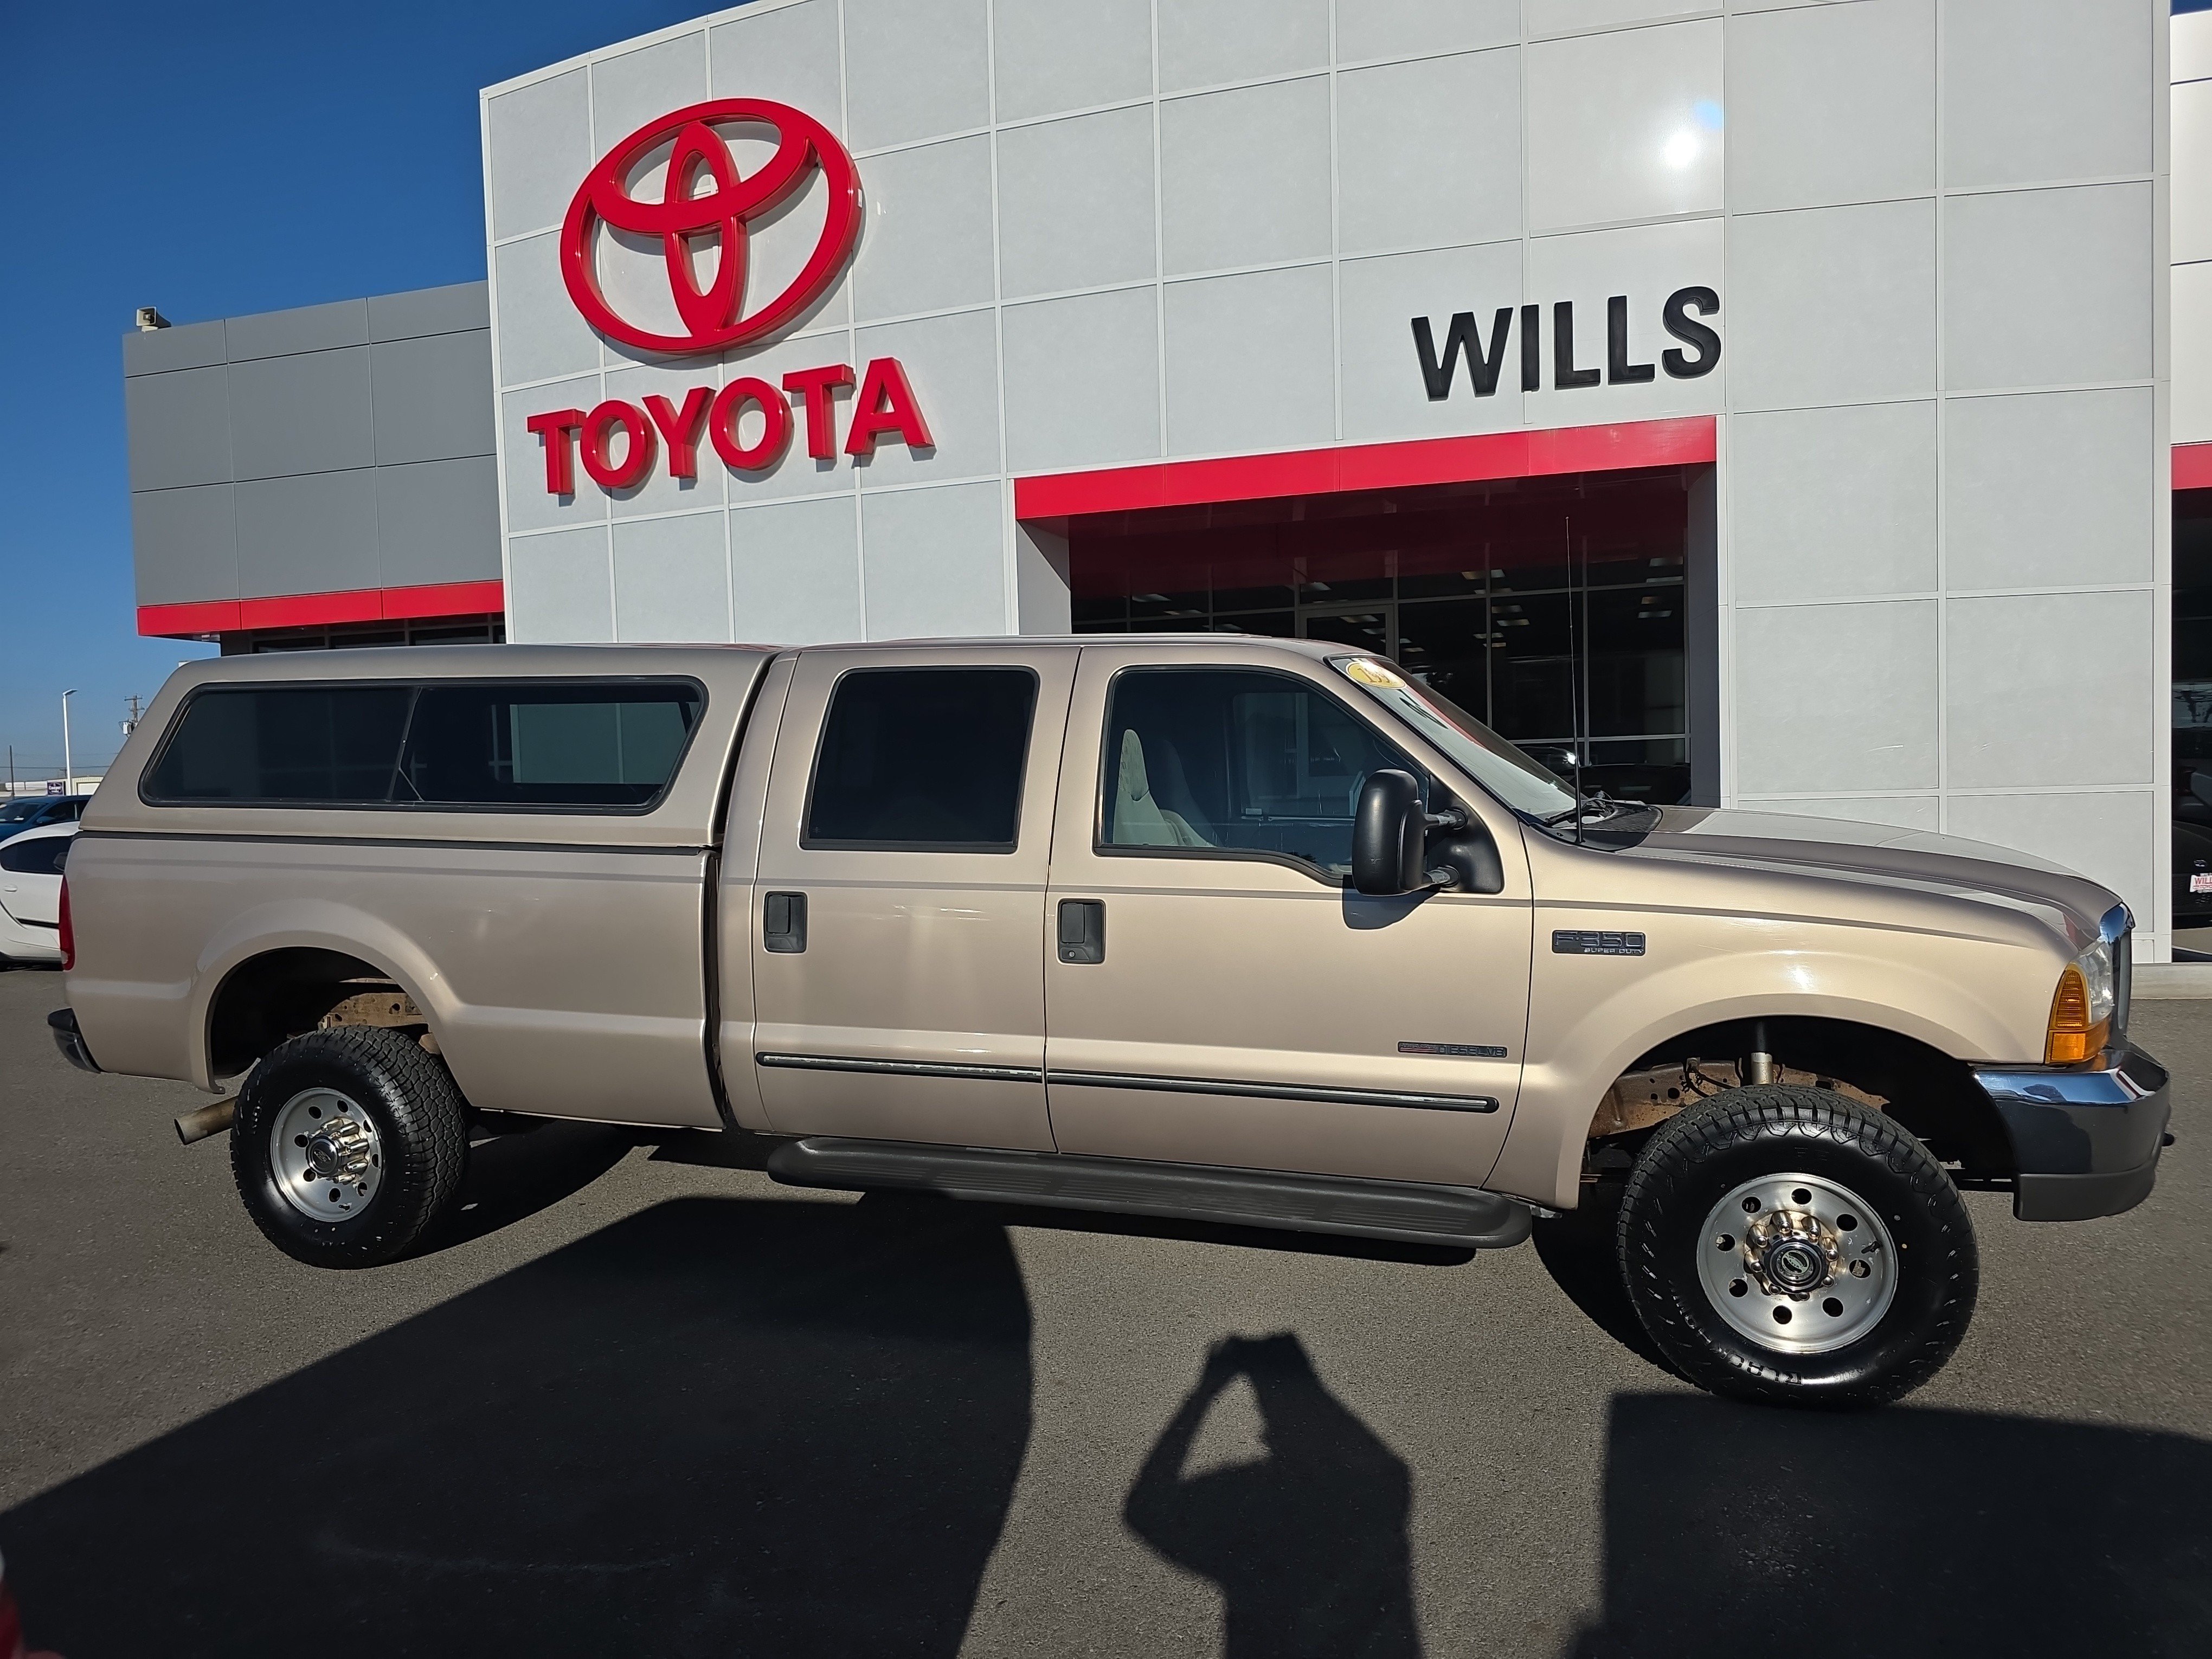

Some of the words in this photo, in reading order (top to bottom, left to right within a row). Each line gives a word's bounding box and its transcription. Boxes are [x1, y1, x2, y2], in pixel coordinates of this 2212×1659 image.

[1411, 286, 1721, 402] WILLS
[527, 357, 934, 496] TOYOTA
[1553, 931, 1644, 948] F-350
[1438, 1045, 1486, 1056] DIESEL
[1487, 1047, 1504, 1056] V8
